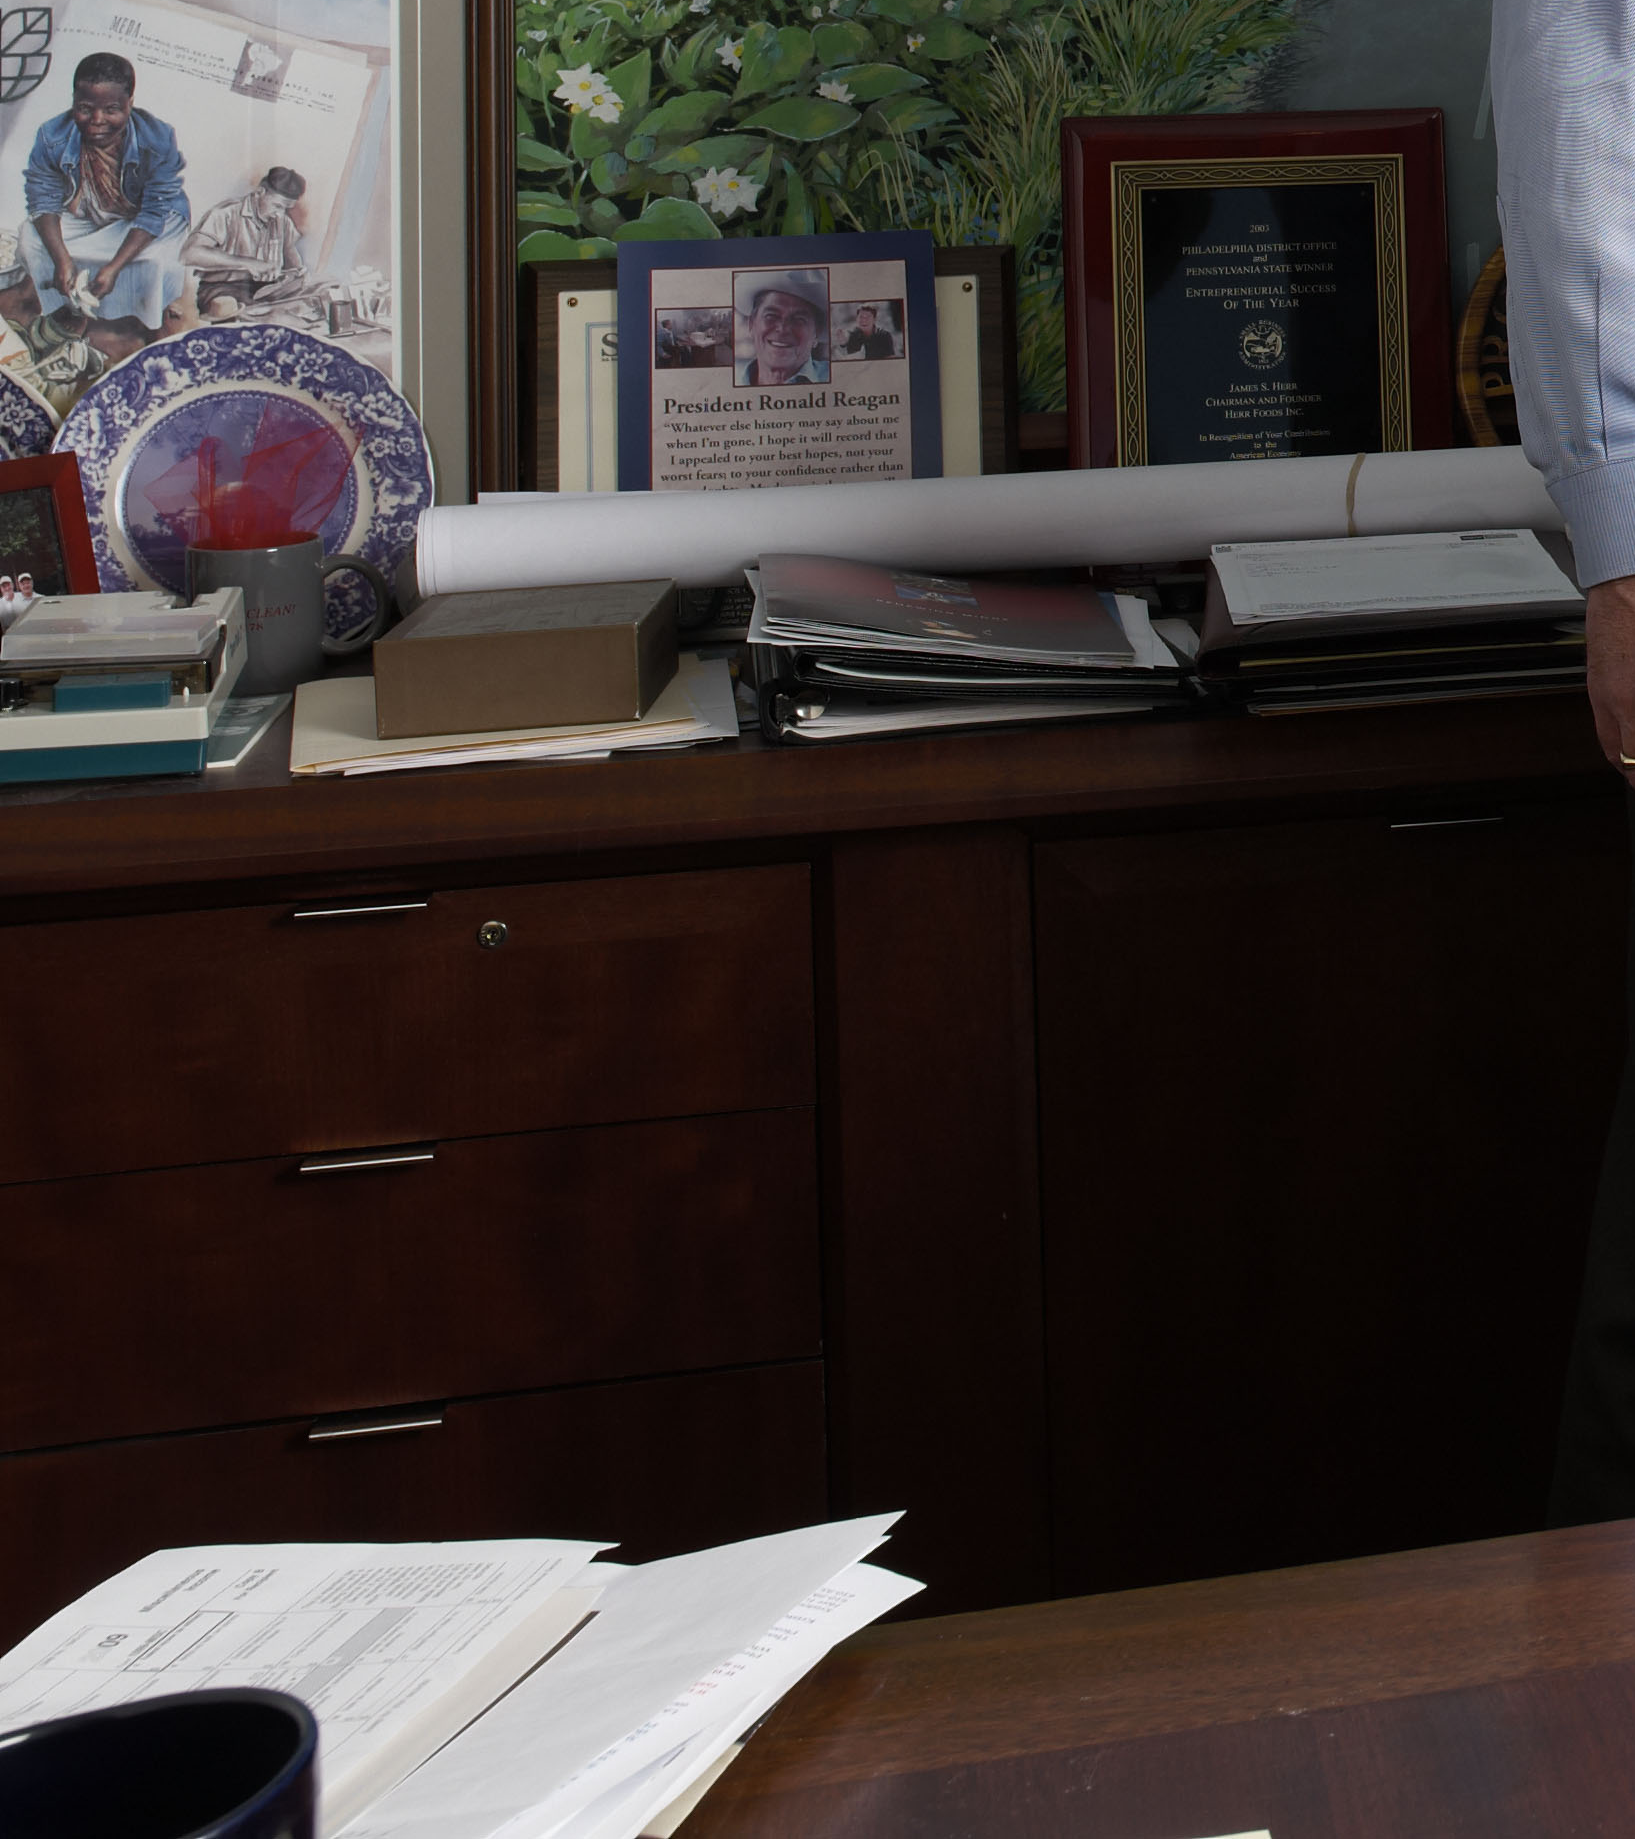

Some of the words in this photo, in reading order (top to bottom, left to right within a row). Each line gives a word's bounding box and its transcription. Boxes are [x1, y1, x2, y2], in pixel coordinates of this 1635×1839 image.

[1181, 243, 1255, 255] PHILADELPHIA
[1256, 242, 1300, 252] DISTRICT
[1302, 241, 1337, 250] OFFICE
[1252, 254, 1268, 262] and
[1185, 265, 1260, 276] PENNSYLVANIA
[1263, 264, 1293, 274] STATE
[1294, 262, 1334, 273] WINNER
[1185, 286, 1286, 298] ENTREPRENEURIAL
[1289, 283, 1337, 295] SUCCESS
[601, 332, 619, 357] S
[1229, 384, 1259, 394] JAMES
[1261, 382, 1270, 392] S.
[1272, 381, 1298, 391] HERR
[663, 396, 753, 414] President
[759, 392, 826, 411] Ronald
[833, 391, 900, 410] Reagan
[1205, 397, 1255, 407] CHAIRMAN
[1280, 394, 1321, 404] FOUNDER
[1224, 409, 1251, 419] HERR
[1253, 408, 1284, 418] FOODS
[730, 421, 750, 431] else
[754, 418, 795, 431] history
[798, 418, 823, 429] may
[825, 416, 845, 428] say
[846, 415, 880, 425] about
[882, 415, 900, 424] me
[666, 438, 697, 449] when
[723, 438, 755, 450] gone,
[758, 435, 764, 445] I
[767, 434, 796, 447] hope
[799, 433, 808, 443] it
[810, 432, 832, 443] will
[836, 430, 872, 441] record
[874, 429, 898, 440] that
[670, 454, 676, 465] I
[679, 453, 730, 466] appealed
[734, 453, 746, 462] to
[749, 452, 775, 463] your
[779, 450, 802, 460] best
[805, 448, 841, 461] hopes,
[846, 448, 865, 458] not
[868, 447, 894, 458] your
[660, 472, 692, 483] worst
[696, 469, 727, 482] fears;
[730, 470, 742, 479] to
[745, 469, 772, 481] your
[775, 464, 838, 477] confidence
[840, 461, 876, 474] rather
[878, 460, 904, 472] than
[246, 603, 297, 619] CLEAN!
